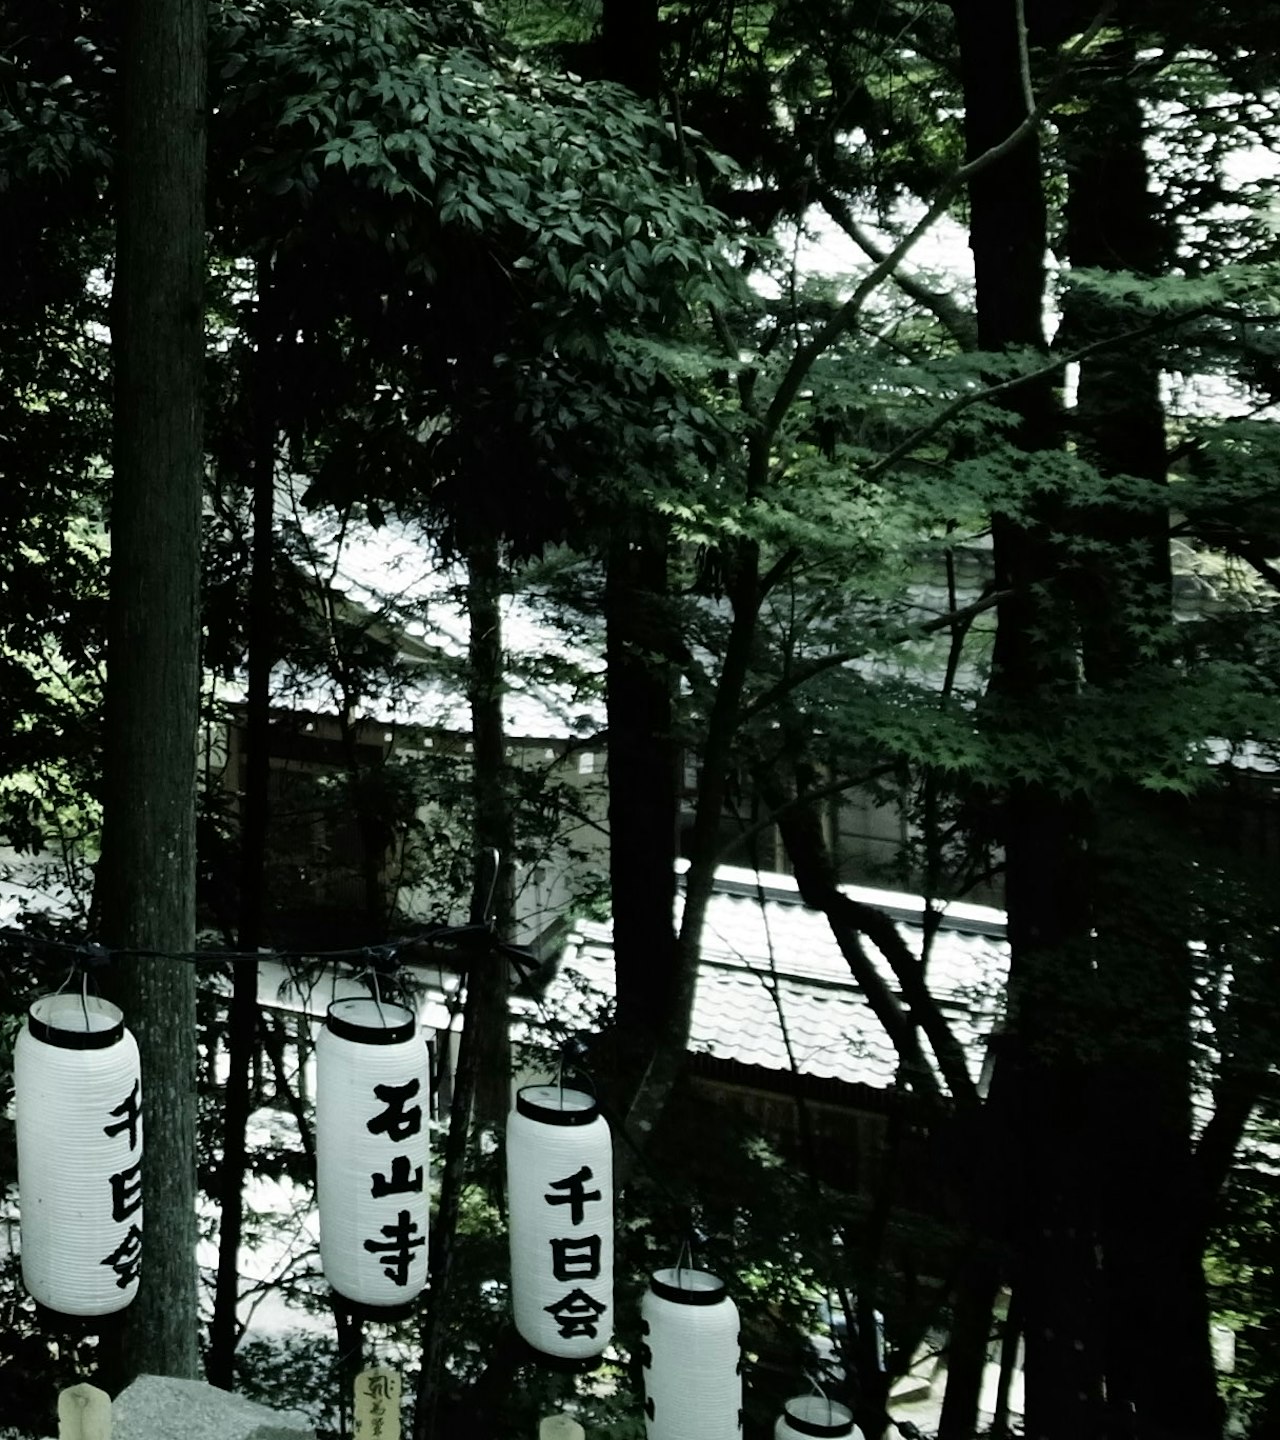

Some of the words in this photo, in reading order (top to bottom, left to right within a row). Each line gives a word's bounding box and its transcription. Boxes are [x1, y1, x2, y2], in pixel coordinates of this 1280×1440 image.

[363, 1078, 426, 1287] 石山寺
[544, 1166, 607, 1340] 千日会
